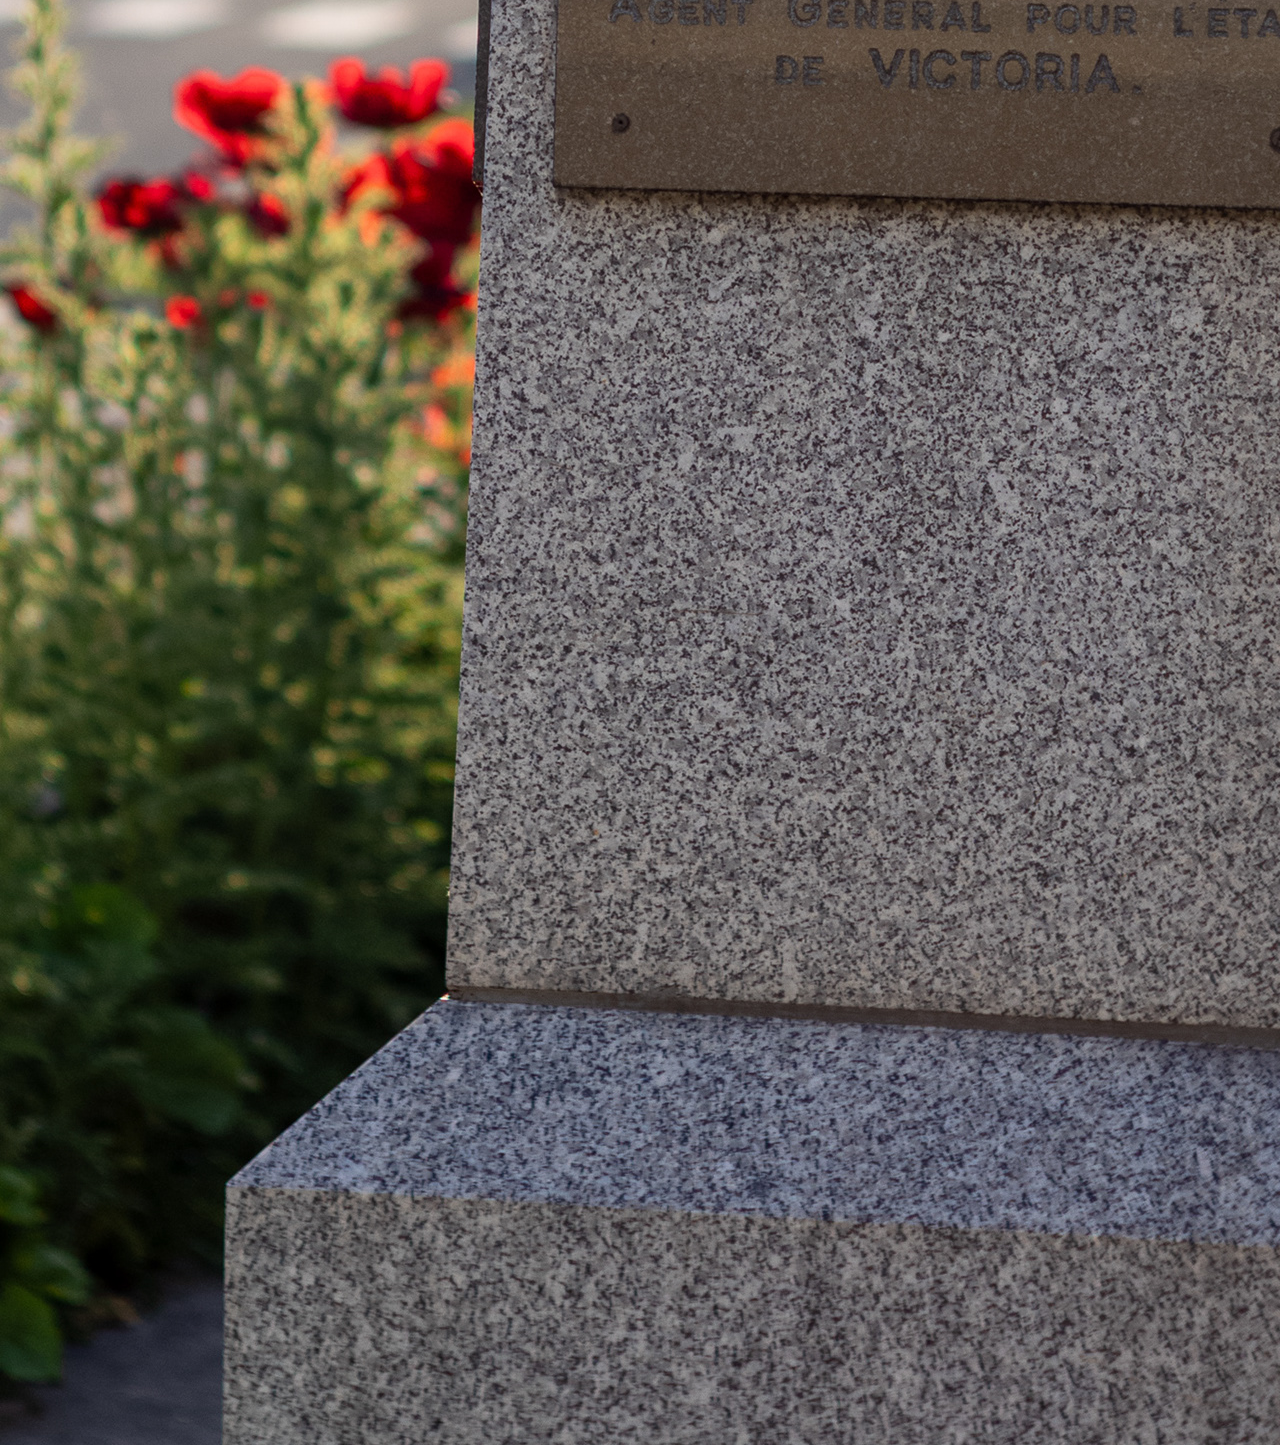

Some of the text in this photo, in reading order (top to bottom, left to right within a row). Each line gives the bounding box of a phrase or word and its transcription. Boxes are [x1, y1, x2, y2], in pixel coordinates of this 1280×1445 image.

[1025, 2, 1139, 37] POUR
[774, 48, 1143, 96] DE VICTORIA.
